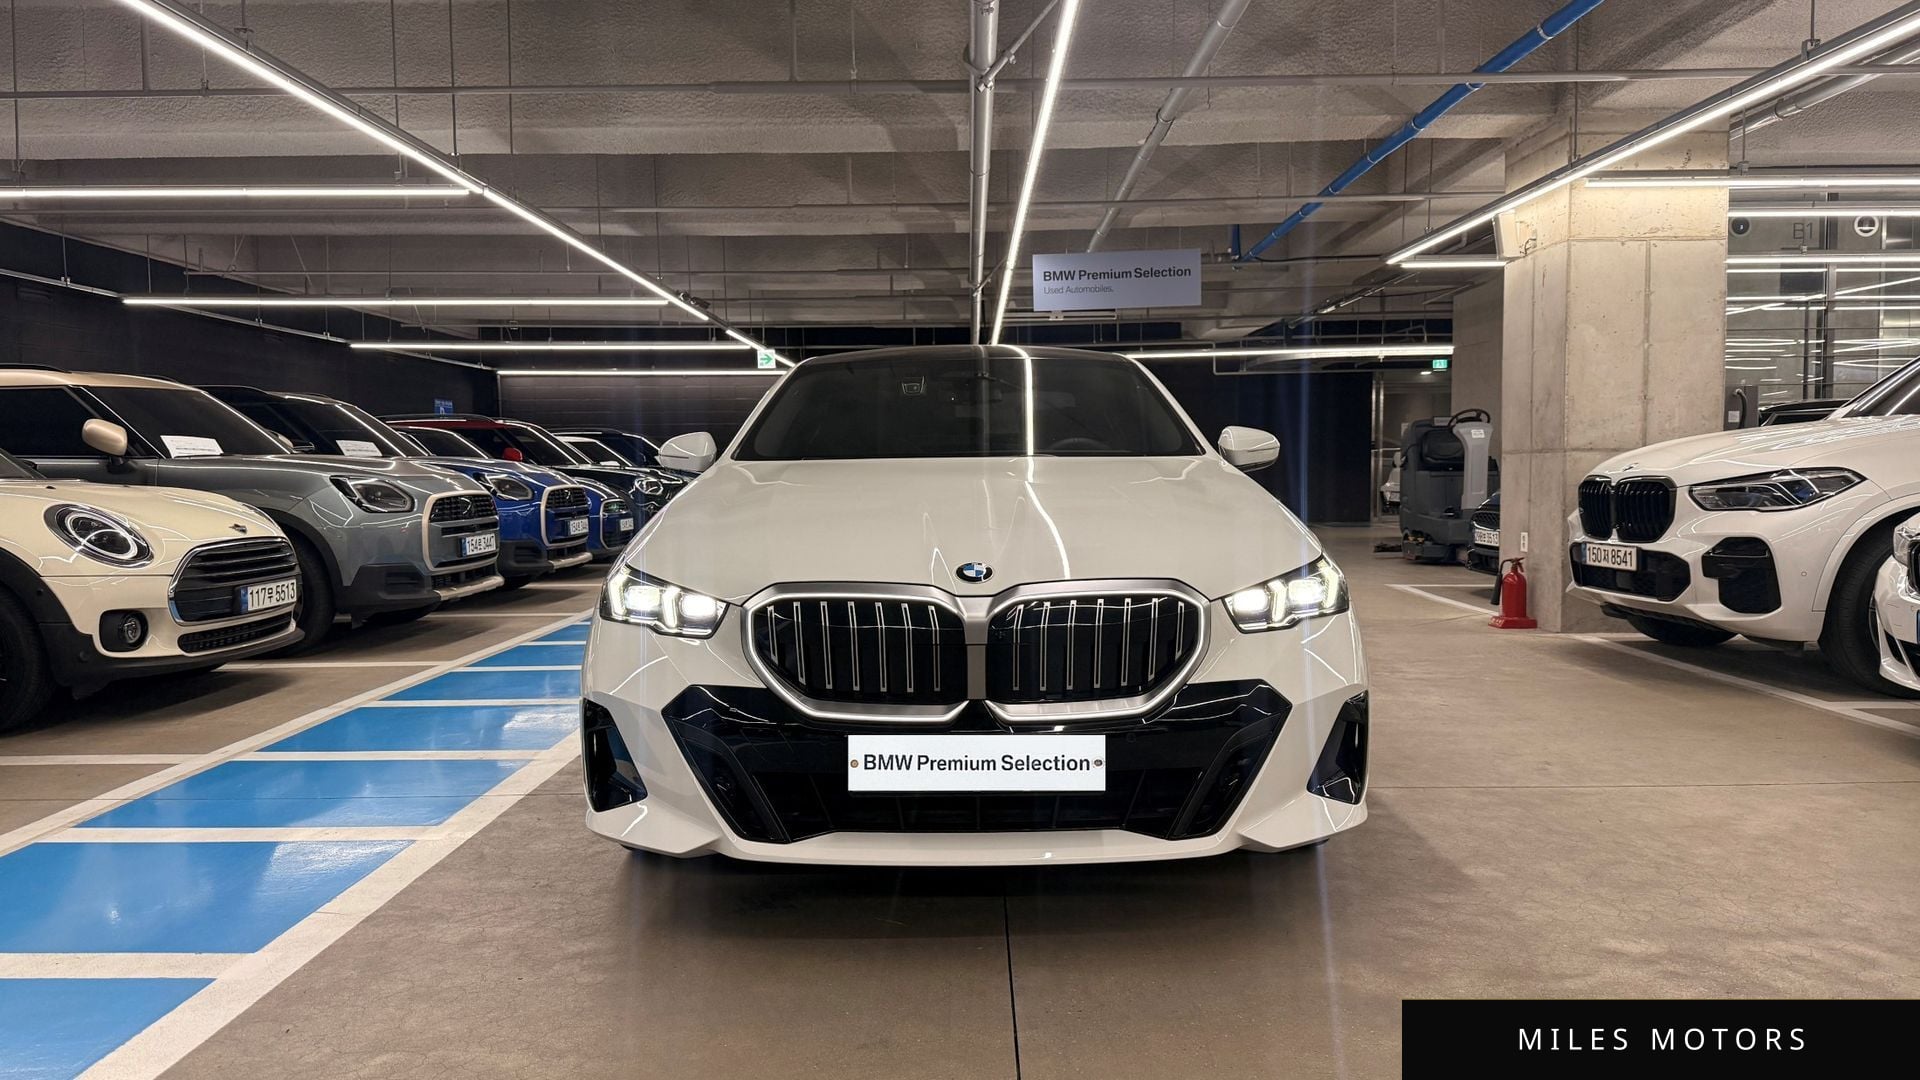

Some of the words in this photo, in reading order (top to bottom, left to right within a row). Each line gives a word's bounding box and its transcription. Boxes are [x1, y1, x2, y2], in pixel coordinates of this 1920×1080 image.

[1043, 269, 1076, 282] BMW
[1078, 268, 1132, 281] Premium
[1134, 266, 1191, 278] Selection
[1043, 286, 1064, 294] Used
[863, 754, 913, 771] BMW
[917, 754, 996, 771] Premium
[1001, 754, 1090, 771] Selection
